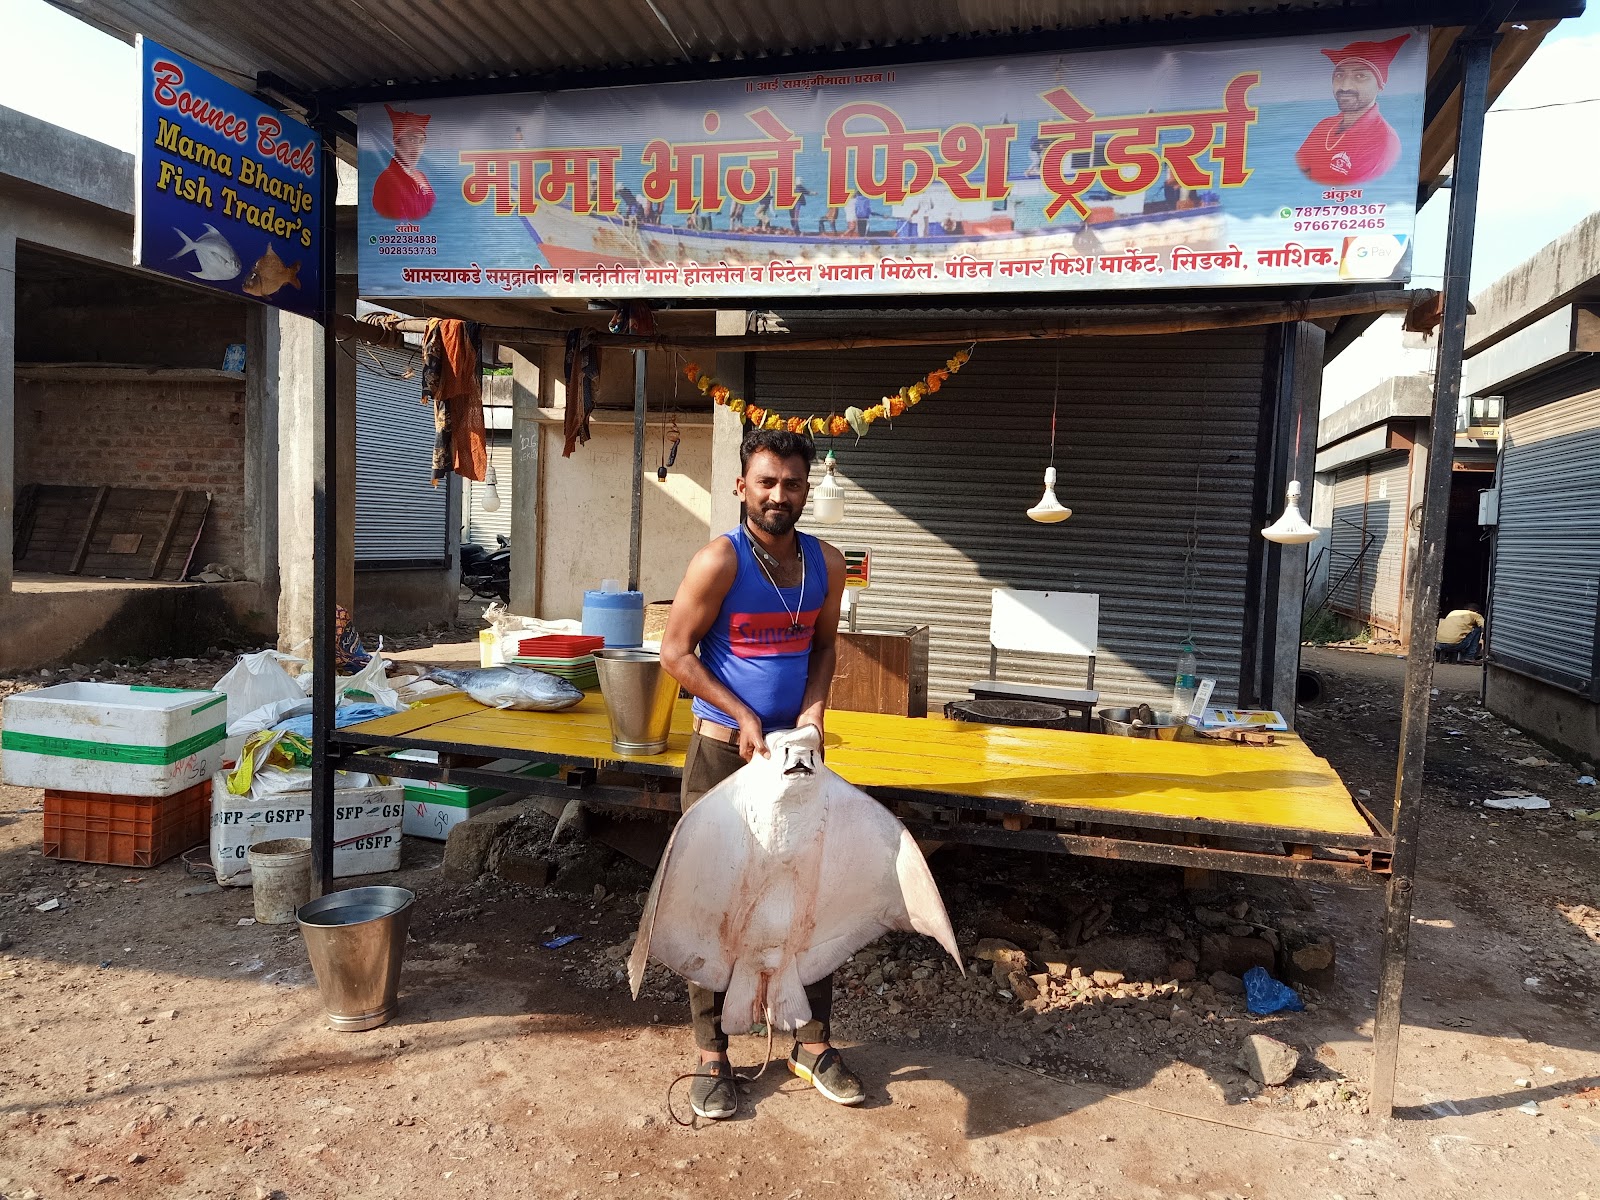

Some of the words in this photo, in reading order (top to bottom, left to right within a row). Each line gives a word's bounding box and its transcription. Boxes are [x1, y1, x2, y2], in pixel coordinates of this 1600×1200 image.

[756, 78, 779, 91] आई
[153, 61, 248, 142] Bounce
[257, 116, 316, 176] Back
[459, 146, 622, 216] मामा
[641, 106, 803, 214] भांजे
[822, 100, 1018, 208] फिश
[1037, 71, 1261, 223] ट्रेडर्स
[155, 117, 233, 177] Mama
[238, 156, 313, 214] Bhanje
[1322, 187, 1363, 203] अंकुश
[156, 160, 213, 208] Fish
[221, 186, 313, 247] Trader's
[1294, 204, 1386, 218] 7875798367
[1293, 218, 1385, 232] 9766762465
[379, 235, 437, 244] 9922384838
[379, 246, 437, 255] 9028353733
[401, 264, 482, 284] आमच्याकडे
[486, 264, 558, 291] समुद्रातील
[562, 269, 576, 284] व
[579, 264, 640, 287] नदीतील
[645, 263, 678, 284] मासे
[684, 262, 745, 286] होलसेल
[750, 267, 763, 283] व
[769, 260, 812, 282] रिटेल
[818, 264, 874, 281] भावात
[880, 257, 938, 280] मिळेल.
[945, 256, 993, 278] पंडित
[999, 259, 1044, 277] नगर
[1049, 252, 1094, 276] फिश
[1099, 248, 1163, 274] मार्केट,
[1172, 245, 1248, 271] सिडको,
[1257, 243, 1339, 268] नाशिक.
[265, 809, 305, 823] GSFP
[336, 806, 364, 820] SFP
[355, 836, 392, 850] GSFP
